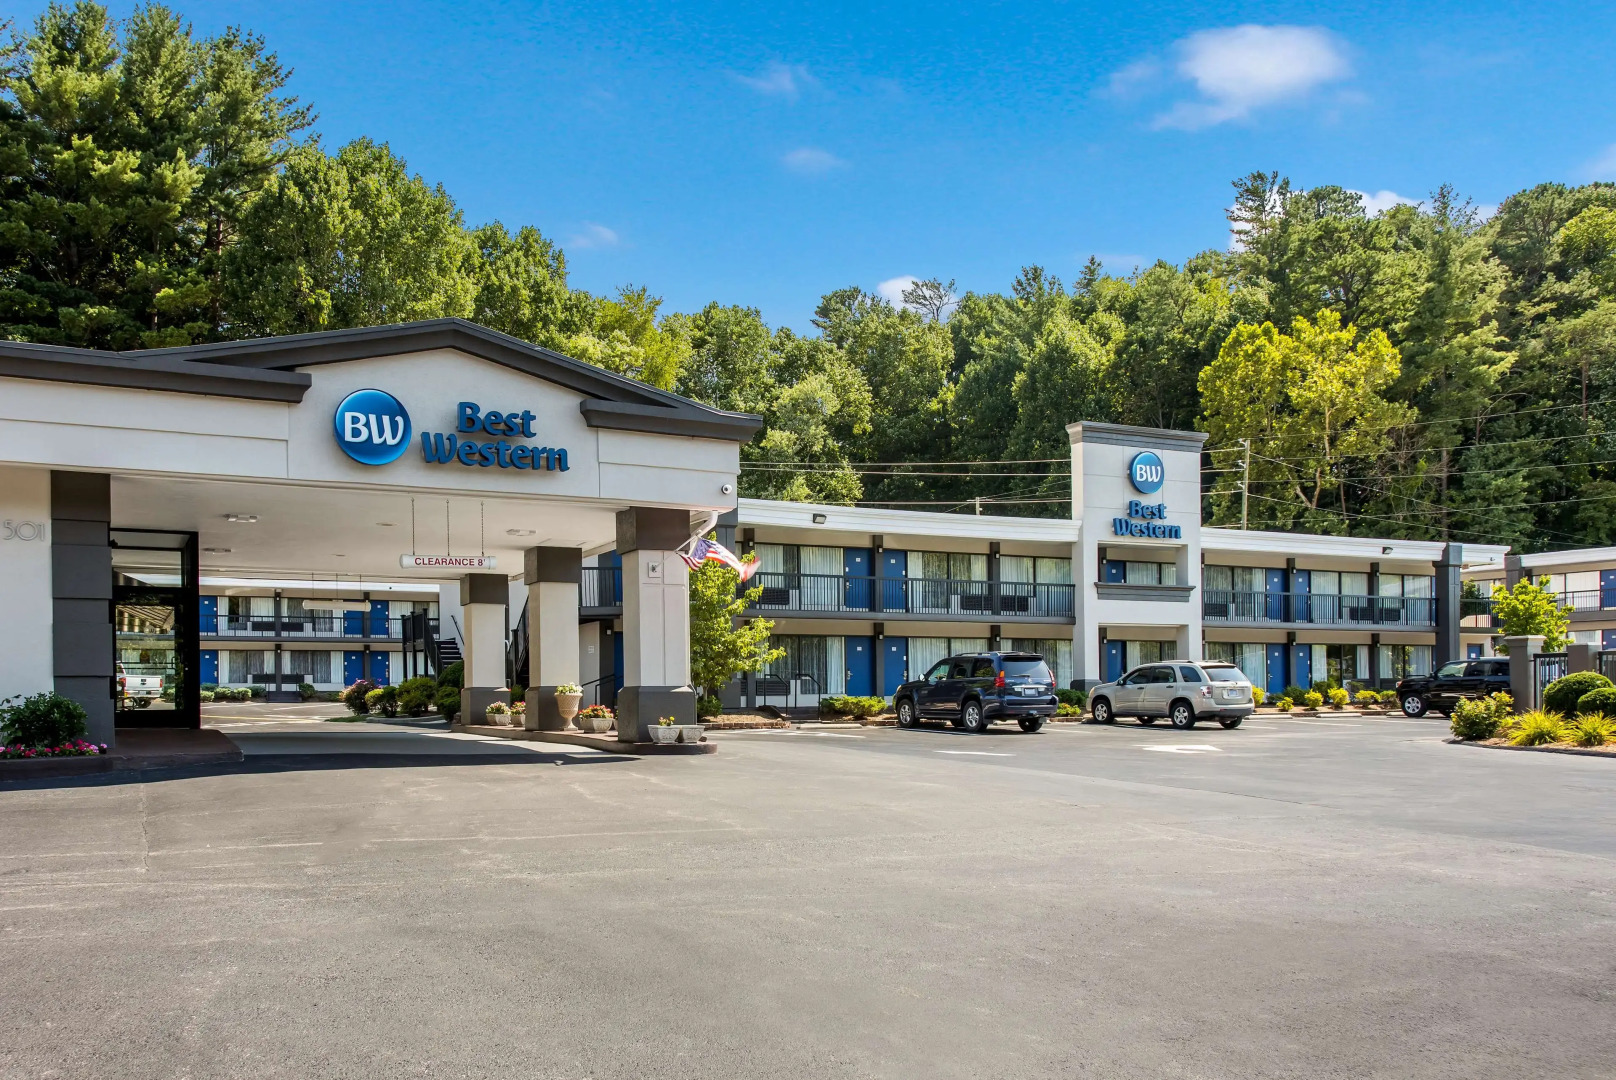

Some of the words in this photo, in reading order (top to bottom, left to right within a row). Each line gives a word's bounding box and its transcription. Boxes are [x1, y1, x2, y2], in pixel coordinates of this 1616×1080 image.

[344, 411, 405, 446] BW
[456, 401, 537, 438] Best
[420, 431, 570, 472] Western
[1136, 464, 1161, 483] BW
[1128, 499, 1167, 519] Best
[3, 519, 46, 541] 501
[1112, 517, 1181, 539] Western
[414, 557, 475, 566] CLEARANCE
